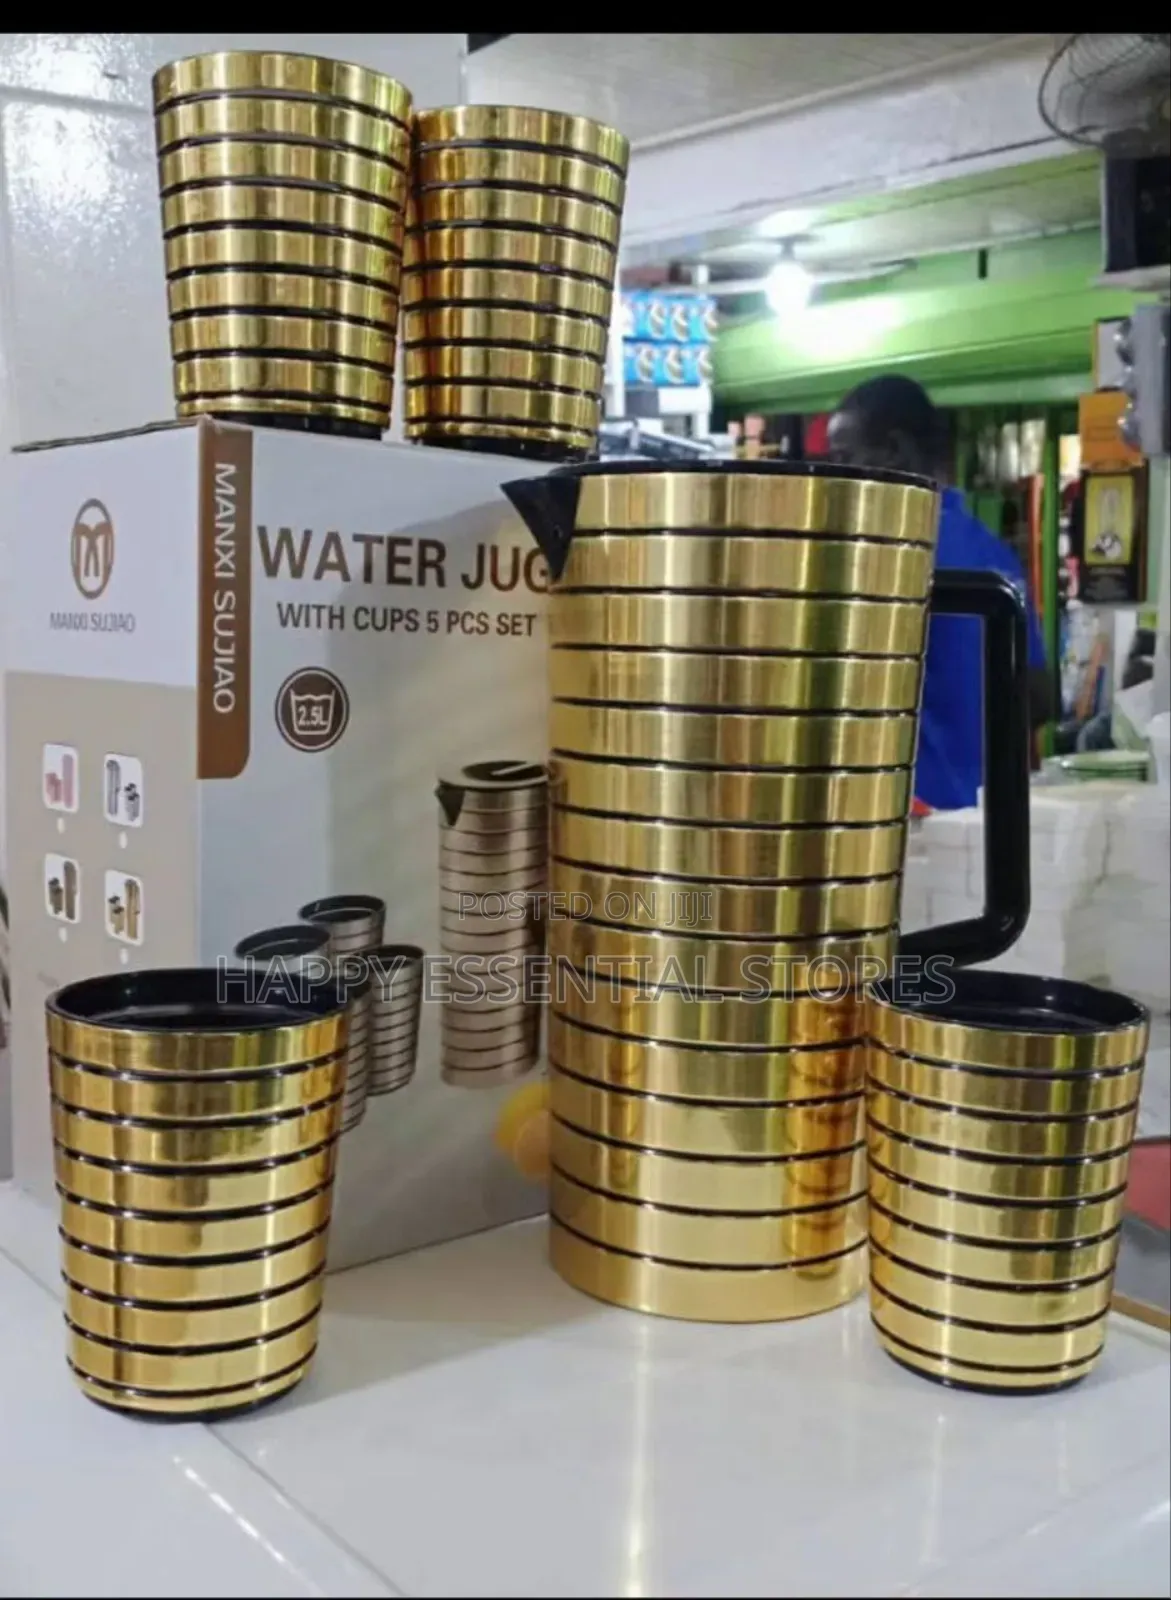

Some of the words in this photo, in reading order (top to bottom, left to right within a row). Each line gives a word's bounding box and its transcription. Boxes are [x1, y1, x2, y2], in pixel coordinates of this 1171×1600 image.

[212, 462, 235, 578] MANXI
[257, 525, 446, 588] WATER
[461, 543, 549, 594] JUG
[213, 590, 236, 713] SUJIAO
[277, 602, 345, 631] WITH
[353, 606, 419, 632] CUPS
[426, 611, 439, 633] 5
[446, 611, 489, 635] PCS
[496, 613, 536, 636] SET
[298, 705, 327, 727] 2.5L
